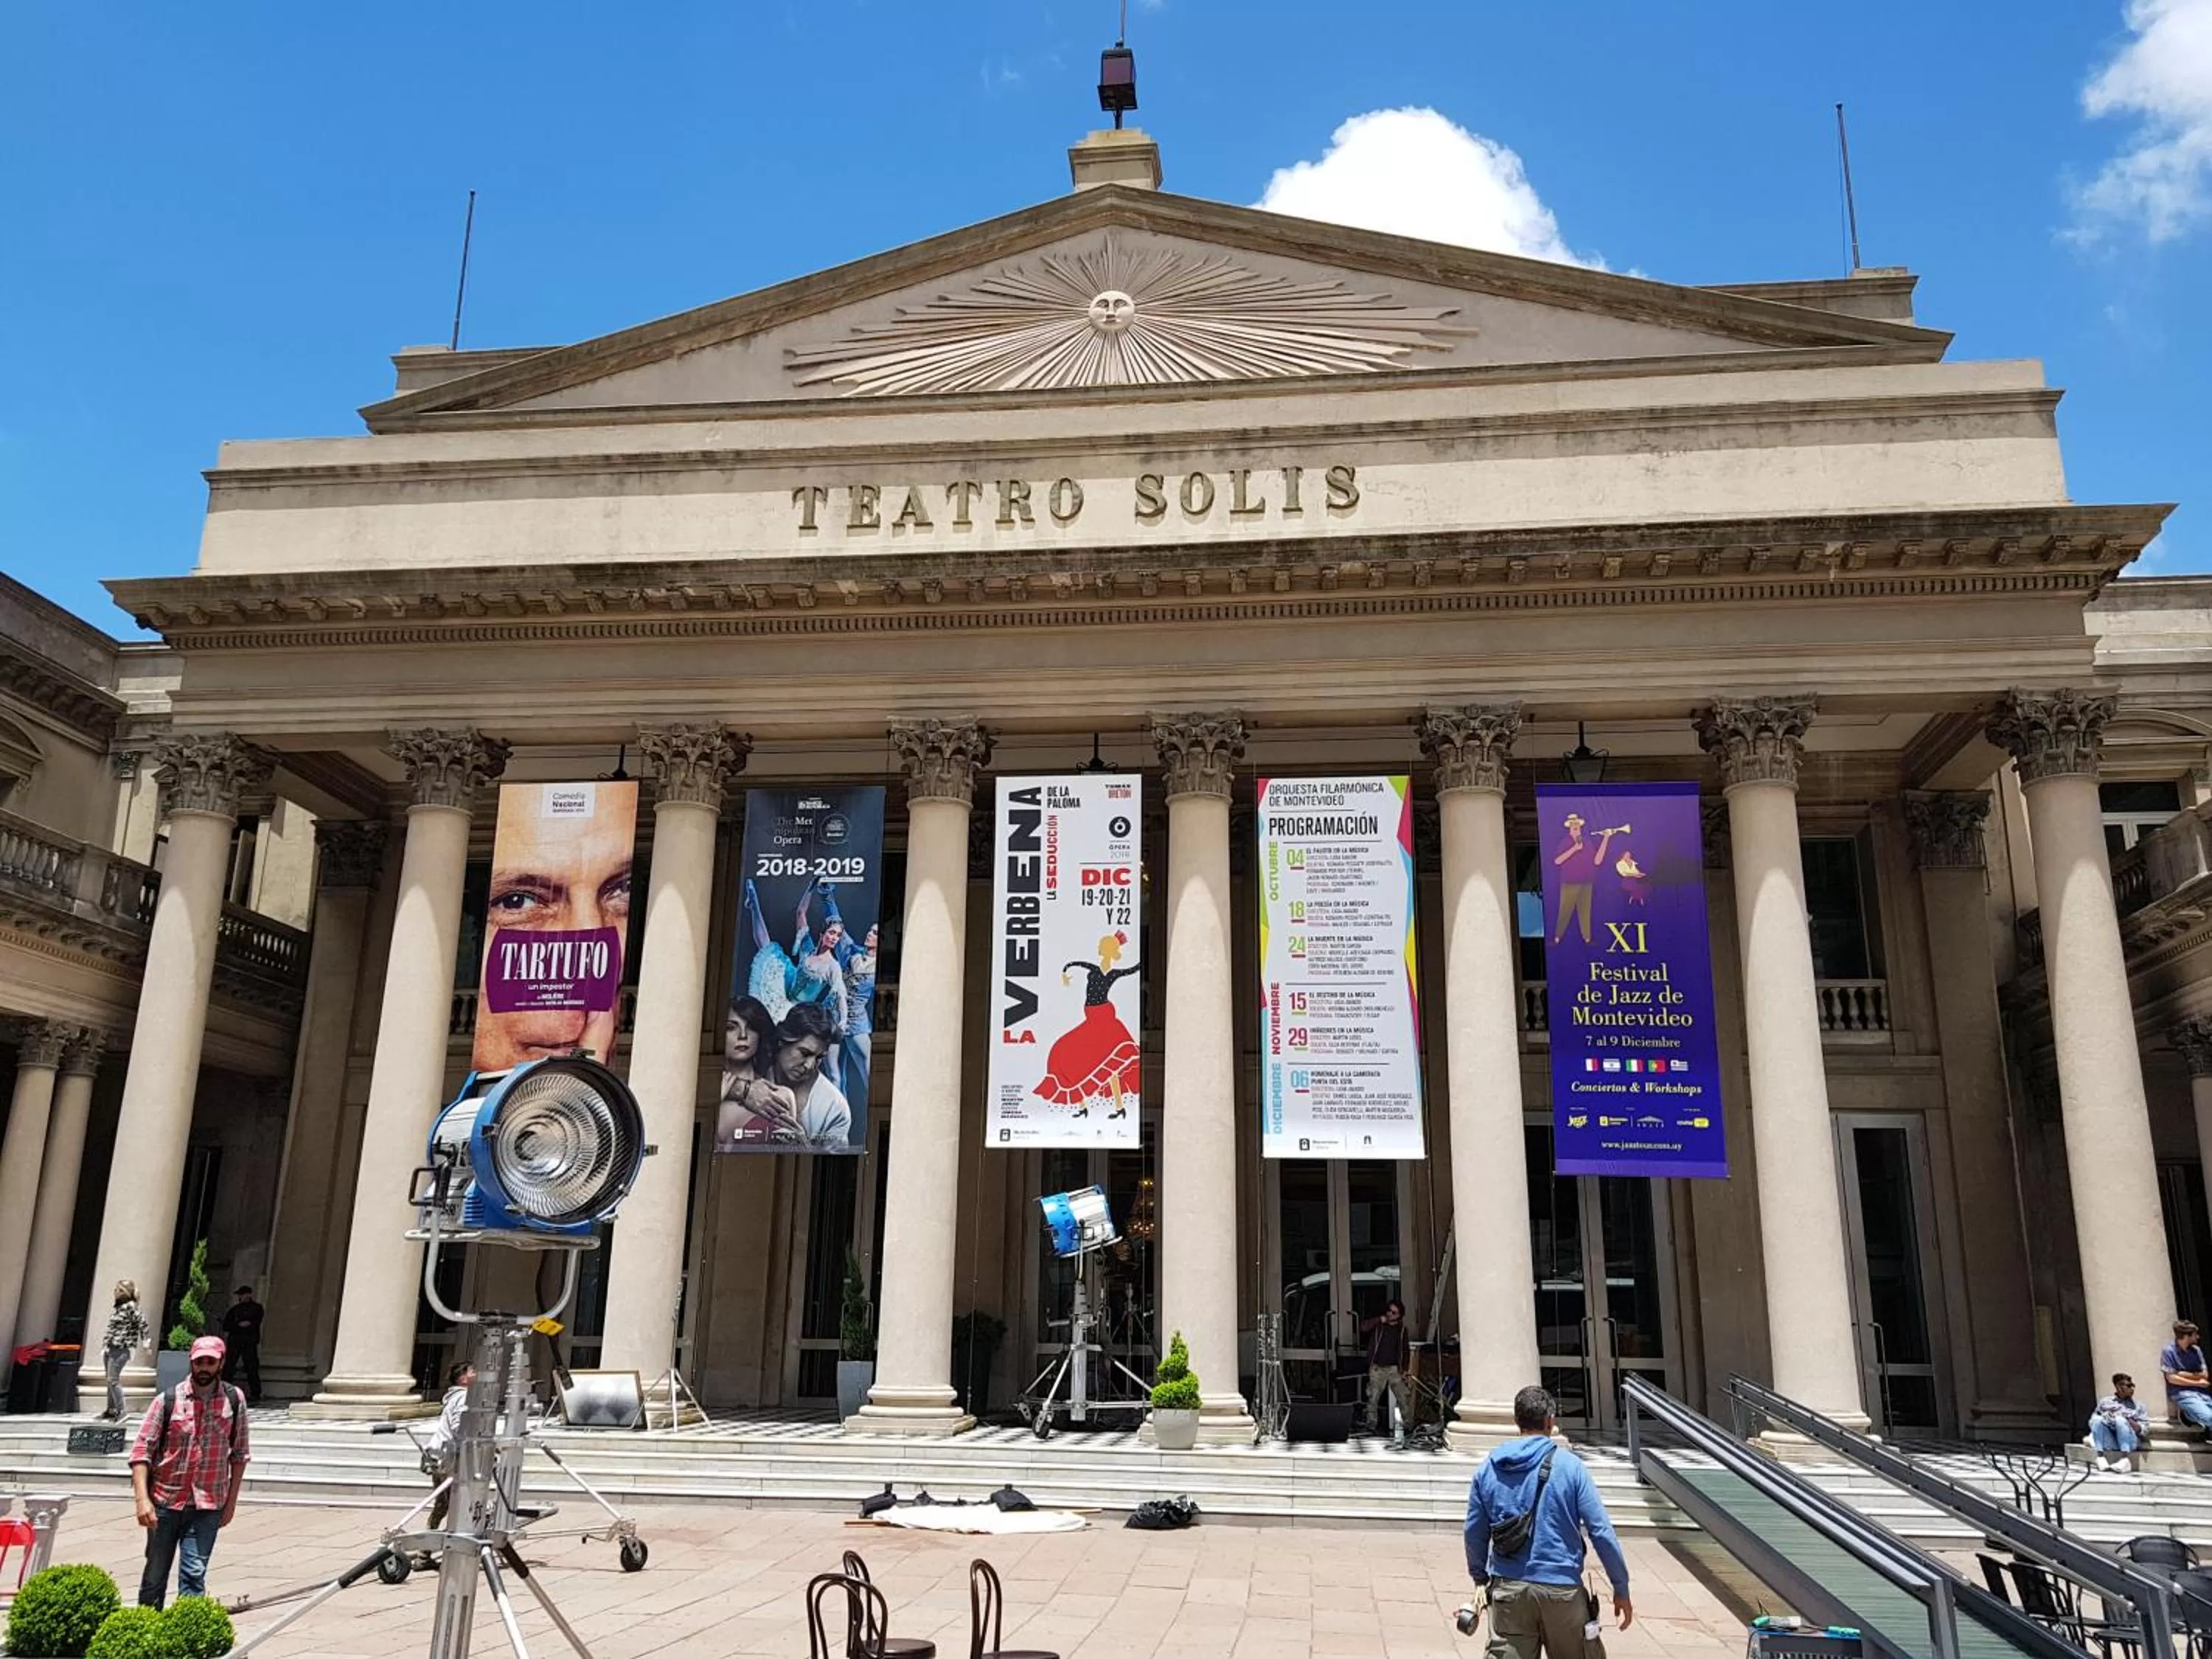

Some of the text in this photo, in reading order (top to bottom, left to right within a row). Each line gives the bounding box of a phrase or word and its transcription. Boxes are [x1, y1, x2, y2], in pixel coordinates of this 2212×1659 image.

[793, 465, 1360, 530] TEATRO SOLIS
[1047, 785, 1070, 797] DE LA
[1269, 784, 1318, 796] ORQUESTA
[1047, 797, 1081, 808] PALOMA
[1269, 795, 1344, 807] DE MONTEVIDEO
[795, 816, 813, 825] Met
[1269, 811, 1378, 836] PROGRAMACIÓN
[773, 835, 802, 846] Opera
[1046, 815, 1058, 900] LA SEDUCCIÓN
[1287, 849, 1304, 866] 04
[756, 857, 865, 877] 2018-2019
[1269, 841, 1279, 900] OCTUBRE
[1082, 867, 1132, 886] DIC
[1082, 888, 1130, 906] 19-20-21
[1004, 787, 1042, 1028] VERBENA
[1106, 908, 1131, 925] Y 22
[1288, 900, 1304, 918] 18
[1287, 936, 1306, 953] 24
[1604, 922, 1649, 953] XI
[501, 941, 608, 981] TARTUFO
[1590, 961, 1669, 982] Festival
[540, 983, 575, 992] impostor
[1577, 984, 1683, 1005] de Jazz de
[1289, 992, 1307, 1010] 15
[1270, 982, 1281, 1055] NOVIEMBRE
[1572, 1006, 1693, 1026] Montevideo
[1004, 1030, 1036, 1044] LA
[1288, 1027, 1308, 1046] 29
[1585, 1035, 1681, 1048] 7 al 9 Diciembre
[1290, 1070, 1310, 1088] 06
[1571, 1081, 1703, 1097] Conciertos & Workshops
[1272, 1063, 1282, 1134] DICIEMBRE
